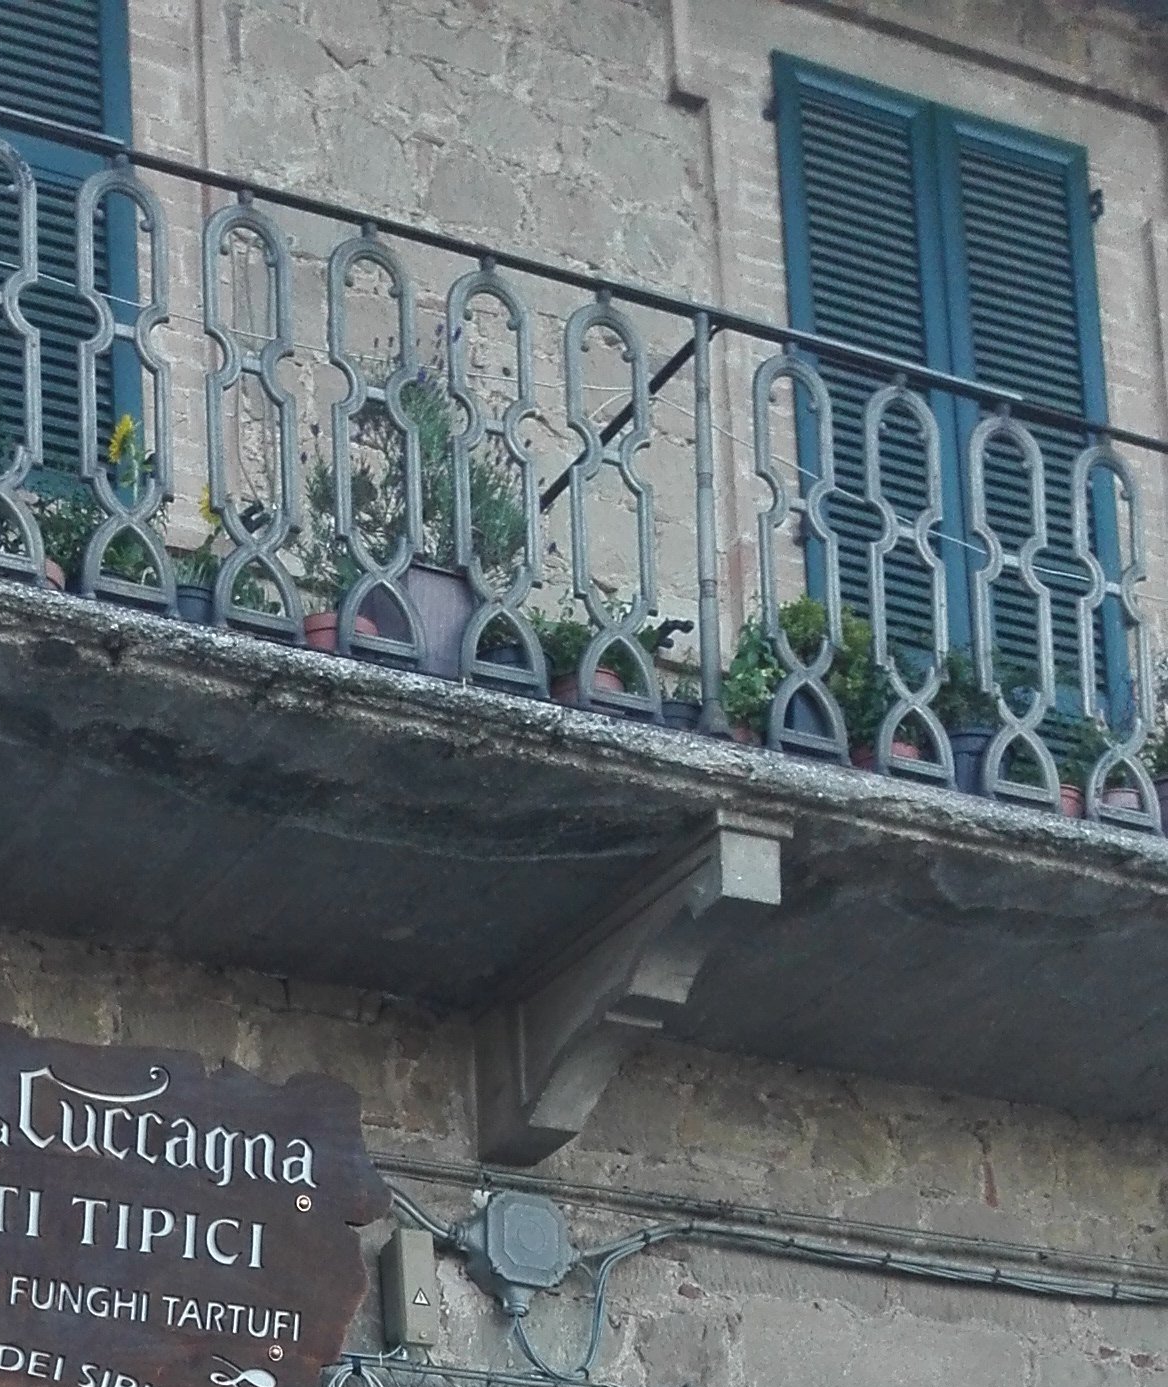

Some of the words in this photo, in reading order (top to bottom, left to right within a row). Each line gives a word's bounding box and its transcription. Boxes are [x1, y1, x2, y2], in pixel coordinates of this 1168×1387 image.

[19, 1065, 315, 1187] Cuccagna
[72, 1196, 266, 1269] TIPICI
[10, 1274, 149, 1323] FUNGHI
[161, 1295, 302, 1342] TARTUFI
